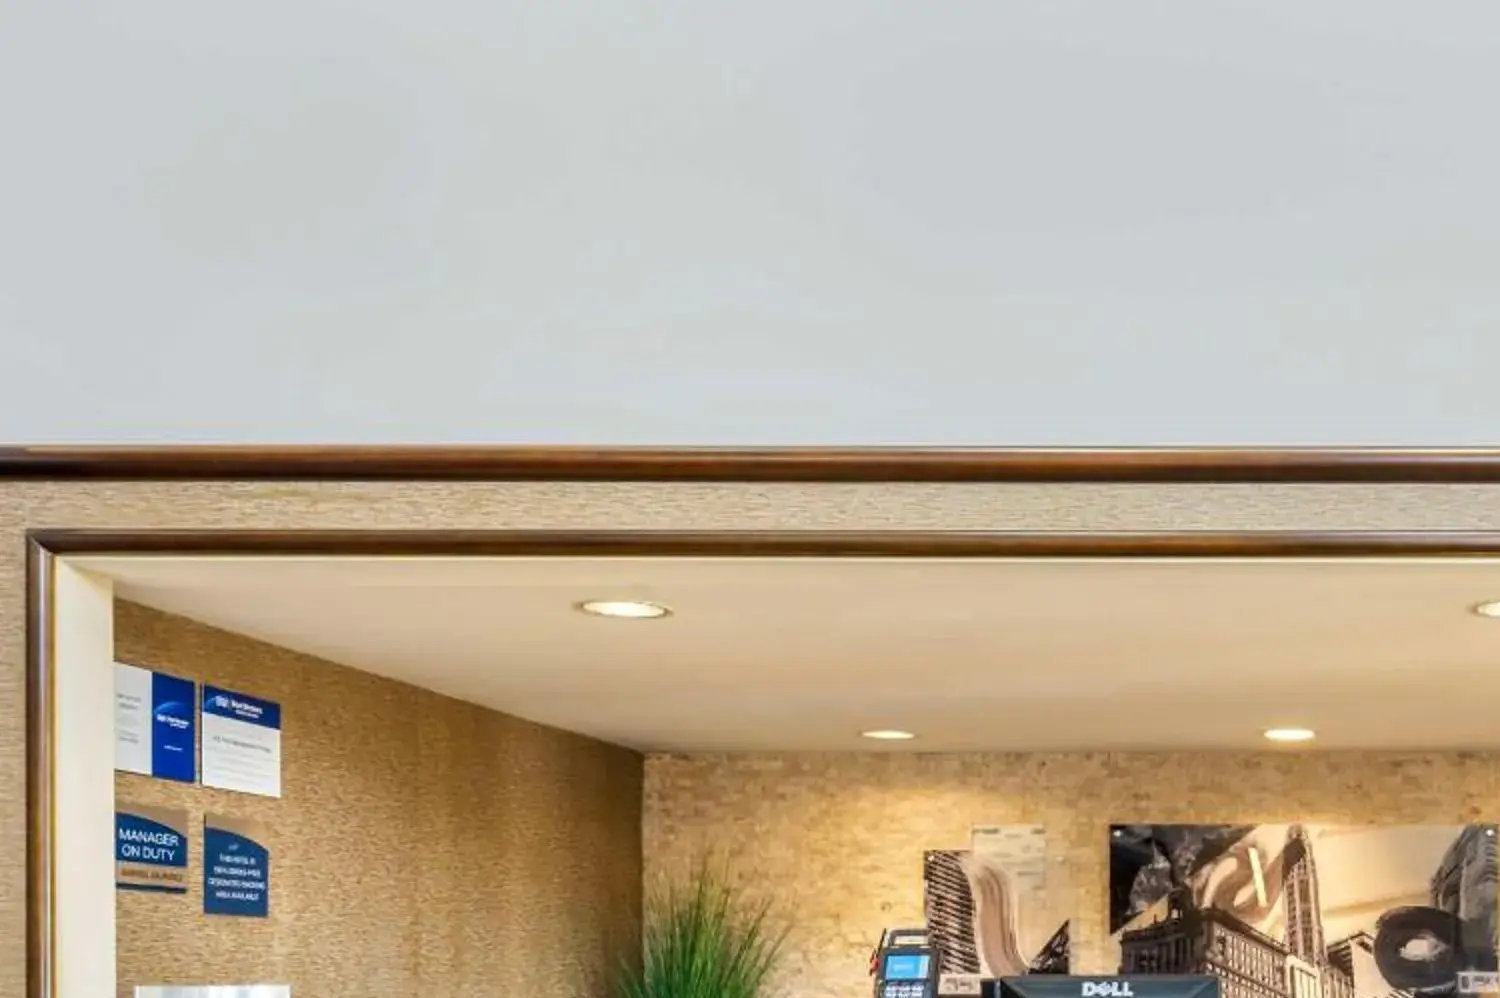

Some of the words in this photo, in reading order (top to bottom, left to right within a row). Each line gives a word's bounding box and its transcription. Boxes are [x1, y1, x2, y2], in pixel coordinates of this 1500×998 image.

[119, 828, 179, 847] MANAGER
[121, 843, 140, 857] ON
[142, 846, 175, 861] DUTY
[1081, 981, 1134, 997] DELL
